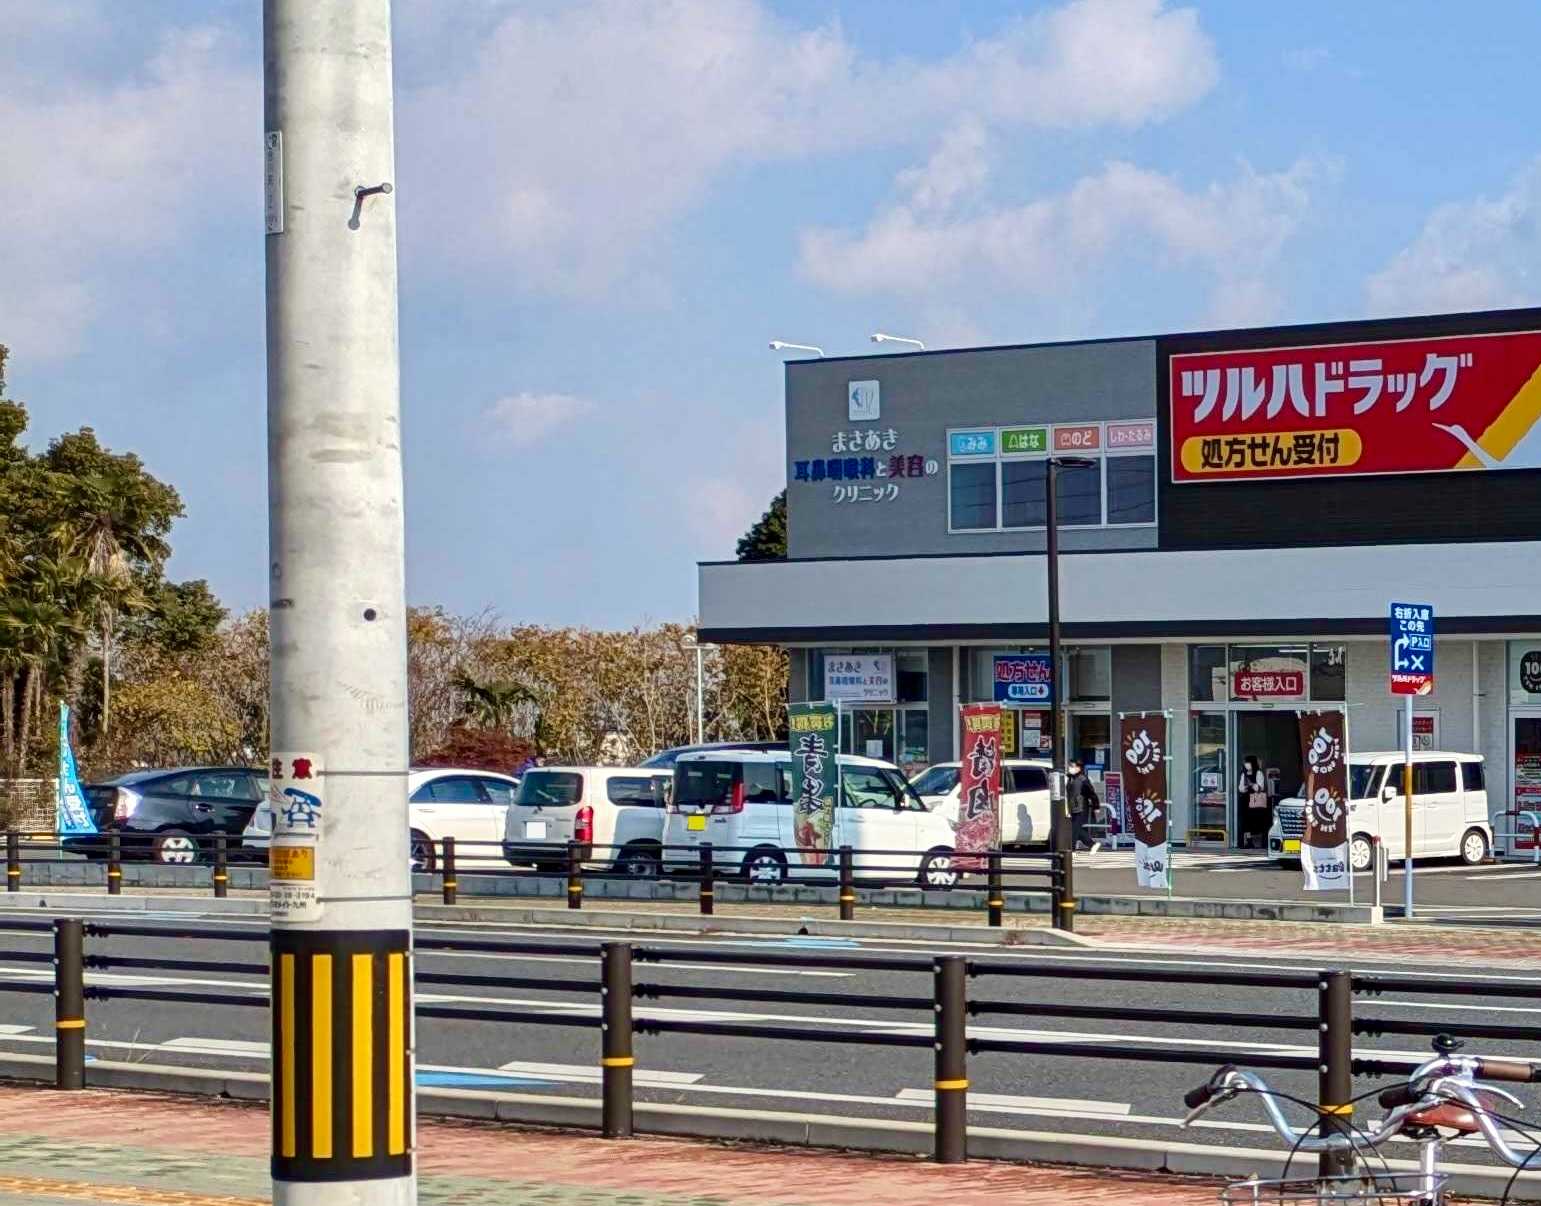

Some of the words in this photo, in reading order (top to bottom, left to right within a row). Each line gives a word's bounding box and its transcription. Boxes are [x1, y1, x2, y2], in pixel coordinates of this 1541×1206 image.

[1181, 351, 1473, 424] ツルハドラッグ
[831, 428, 899, 453] まさあき
[967, 436, 988, 450] みみ
[1019, 433, 1040, 449] はな
[1072, 430, 1093, 446] のど
[1201, 432, 1340, 470] 処方せん受付
[832, 482, 899, 503] クリニック
[1240, 676, 1297, 691] お客様入口
